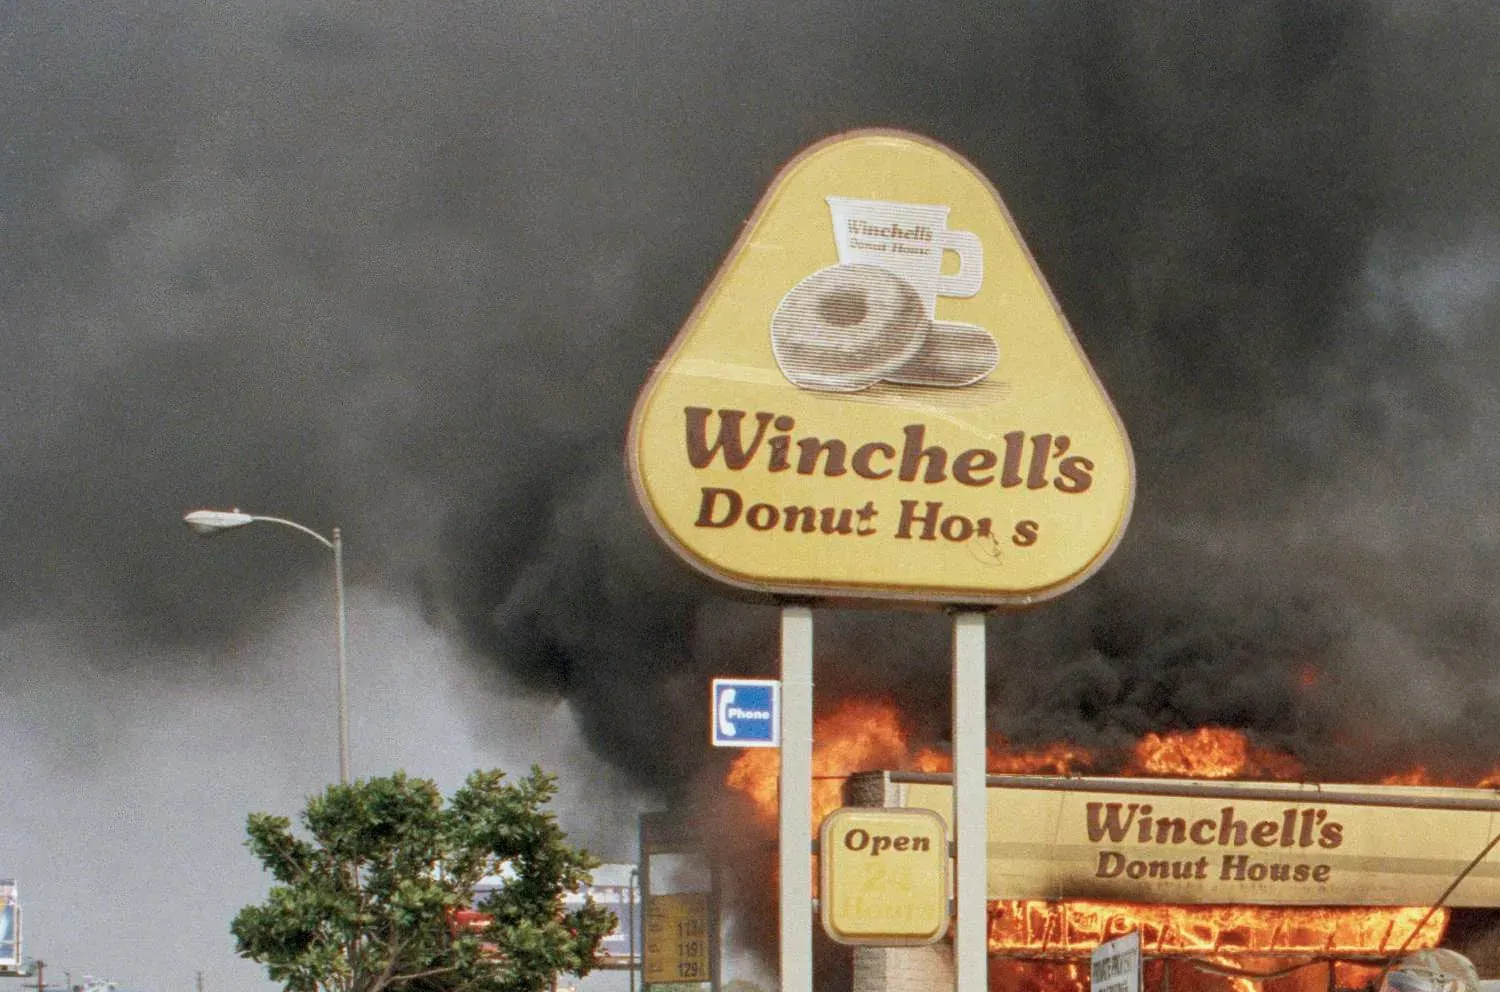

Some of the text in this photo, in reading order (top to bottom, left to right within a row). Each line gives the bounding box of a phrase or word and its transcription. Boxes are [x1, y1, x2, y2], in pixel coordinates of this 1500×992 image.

[684, 405, 1095, 494] Winchell's
[694, 487, 879, 537] Donut
[728, 707, 770, 720] Phone
[844, 828, 931, 856] Open
[1086, 802, 1344, 849] Winchell's
[1095, 850, 1332, 883] Donut House
